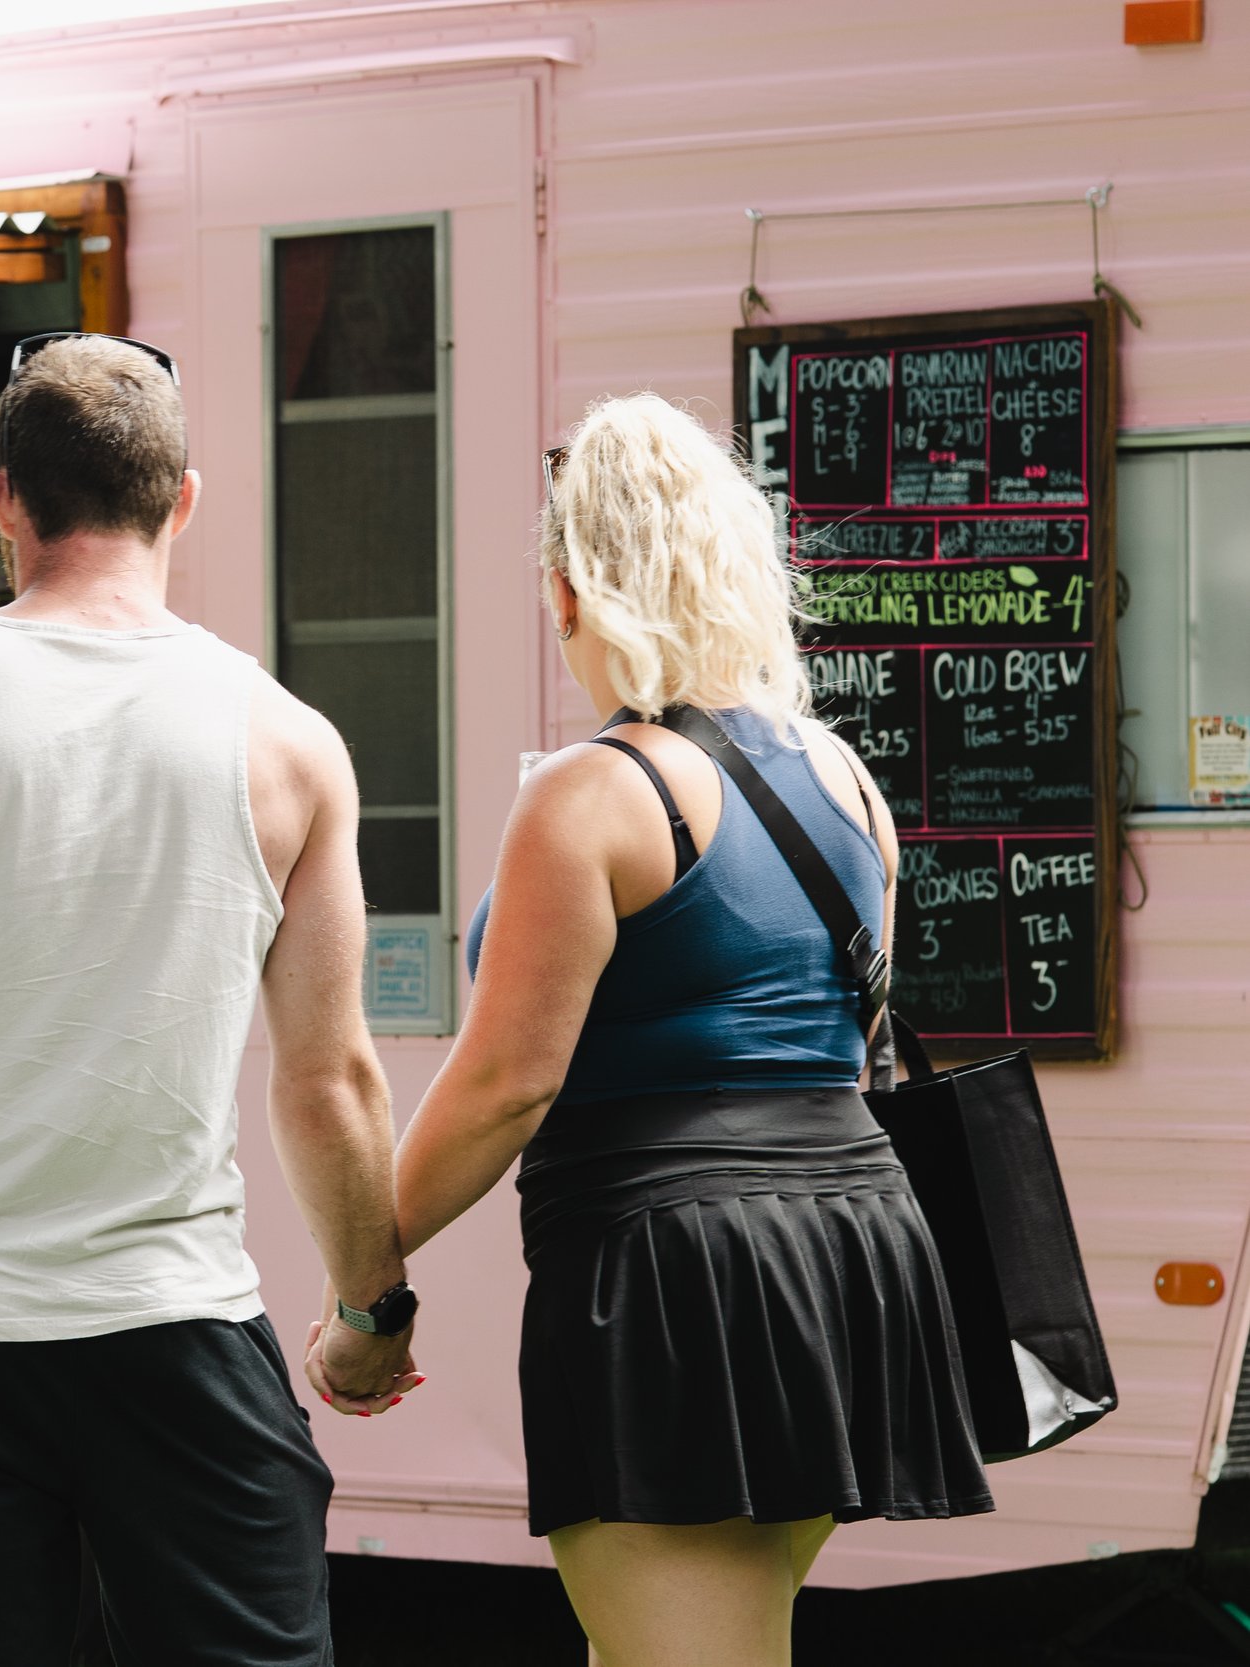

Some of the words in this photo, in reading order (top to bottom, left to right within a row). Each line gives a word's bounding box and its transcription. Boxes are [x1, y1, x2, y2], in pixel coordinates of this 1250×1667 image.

[798, 355, 892, 392] POPCORN
[901, 351, 987, 387] BAVARIAN
[995, 340, 1083, 378] NACHOS
[906, 386, 989, 418] PRETZEL
[991, 387, 1082, 421] CHEESE
[880, 570, 937, 593] CREEK
[940, 567, 1006, 591] CIDERS
[926, 590, 1051, 626] LEMONADE
[806, 650, 897, 698] ONADE
[934, 653, 997, 700] COLD
[1004, 649, 1087, 693] BREW
[898, 843, 942, 881] OOK
[1009, 852, 1095, 897] COFFEE
[913, 867, 1000, 910] COOKIES
[1020, 912, 1073, 947] TEA
